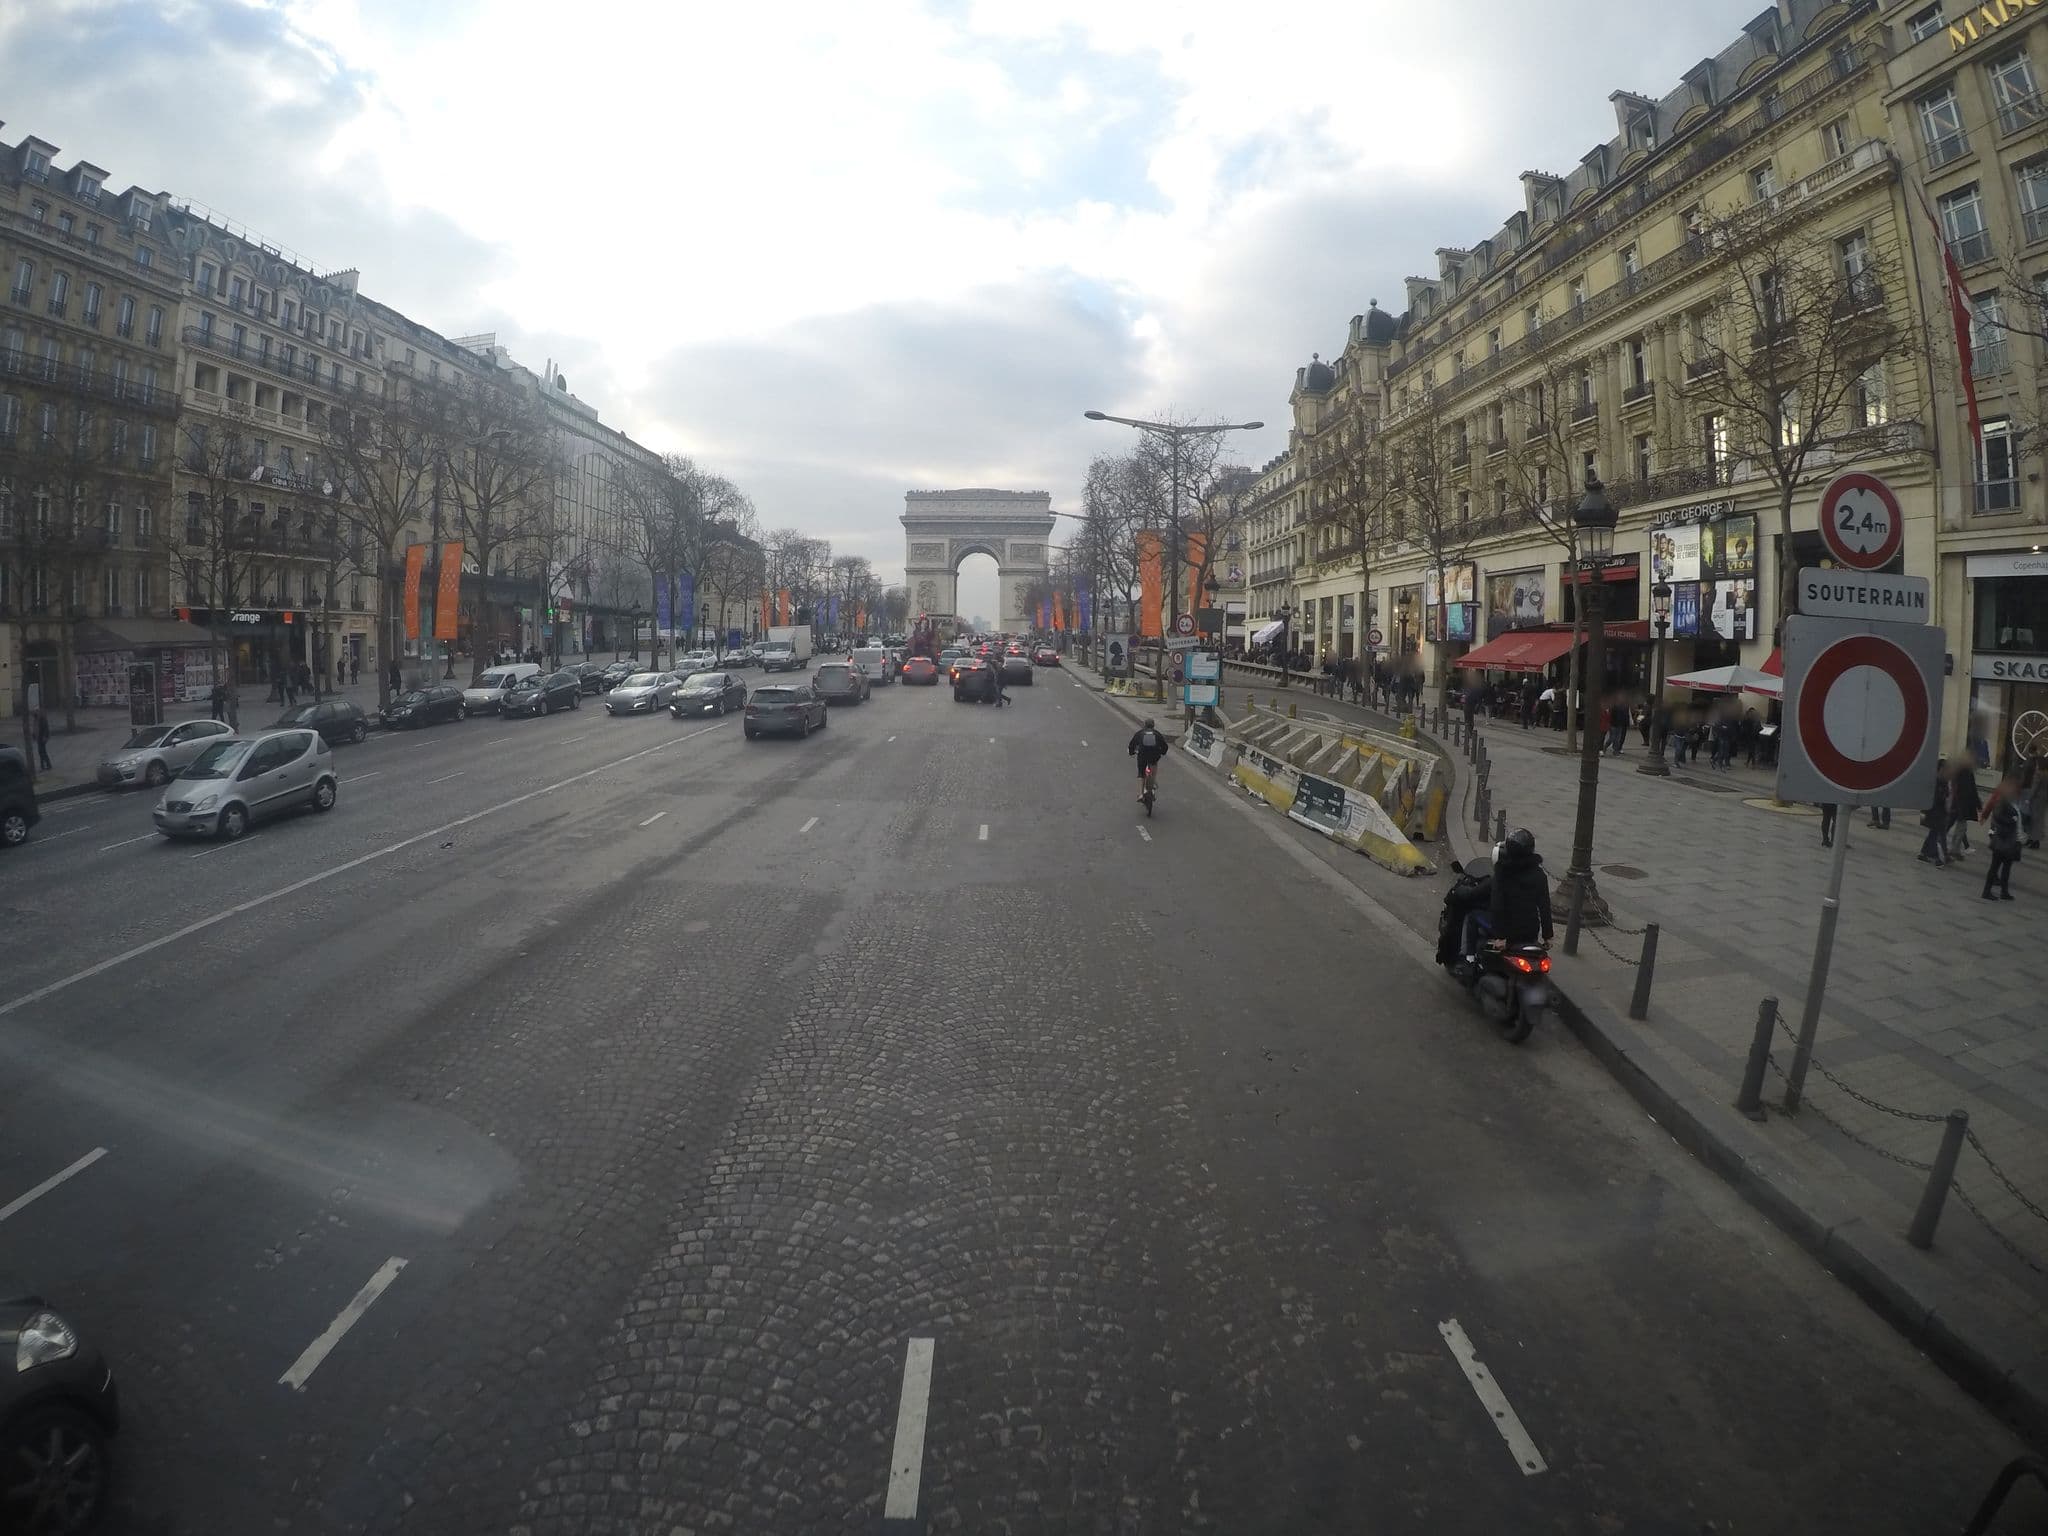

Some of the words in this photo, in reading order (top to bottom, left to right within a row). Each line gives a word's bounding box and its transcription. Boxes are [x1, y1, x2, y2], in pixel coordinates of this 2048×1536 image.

[1656, 510, 1677, 524] UGC
[1681, 502, 1723, 520] GEORGE
[1727, 500, 1735, 513] V
[1839, 505, 1888, 535] 2,4m
[1807, 583, 1924, 609] SOUTERRAIN
